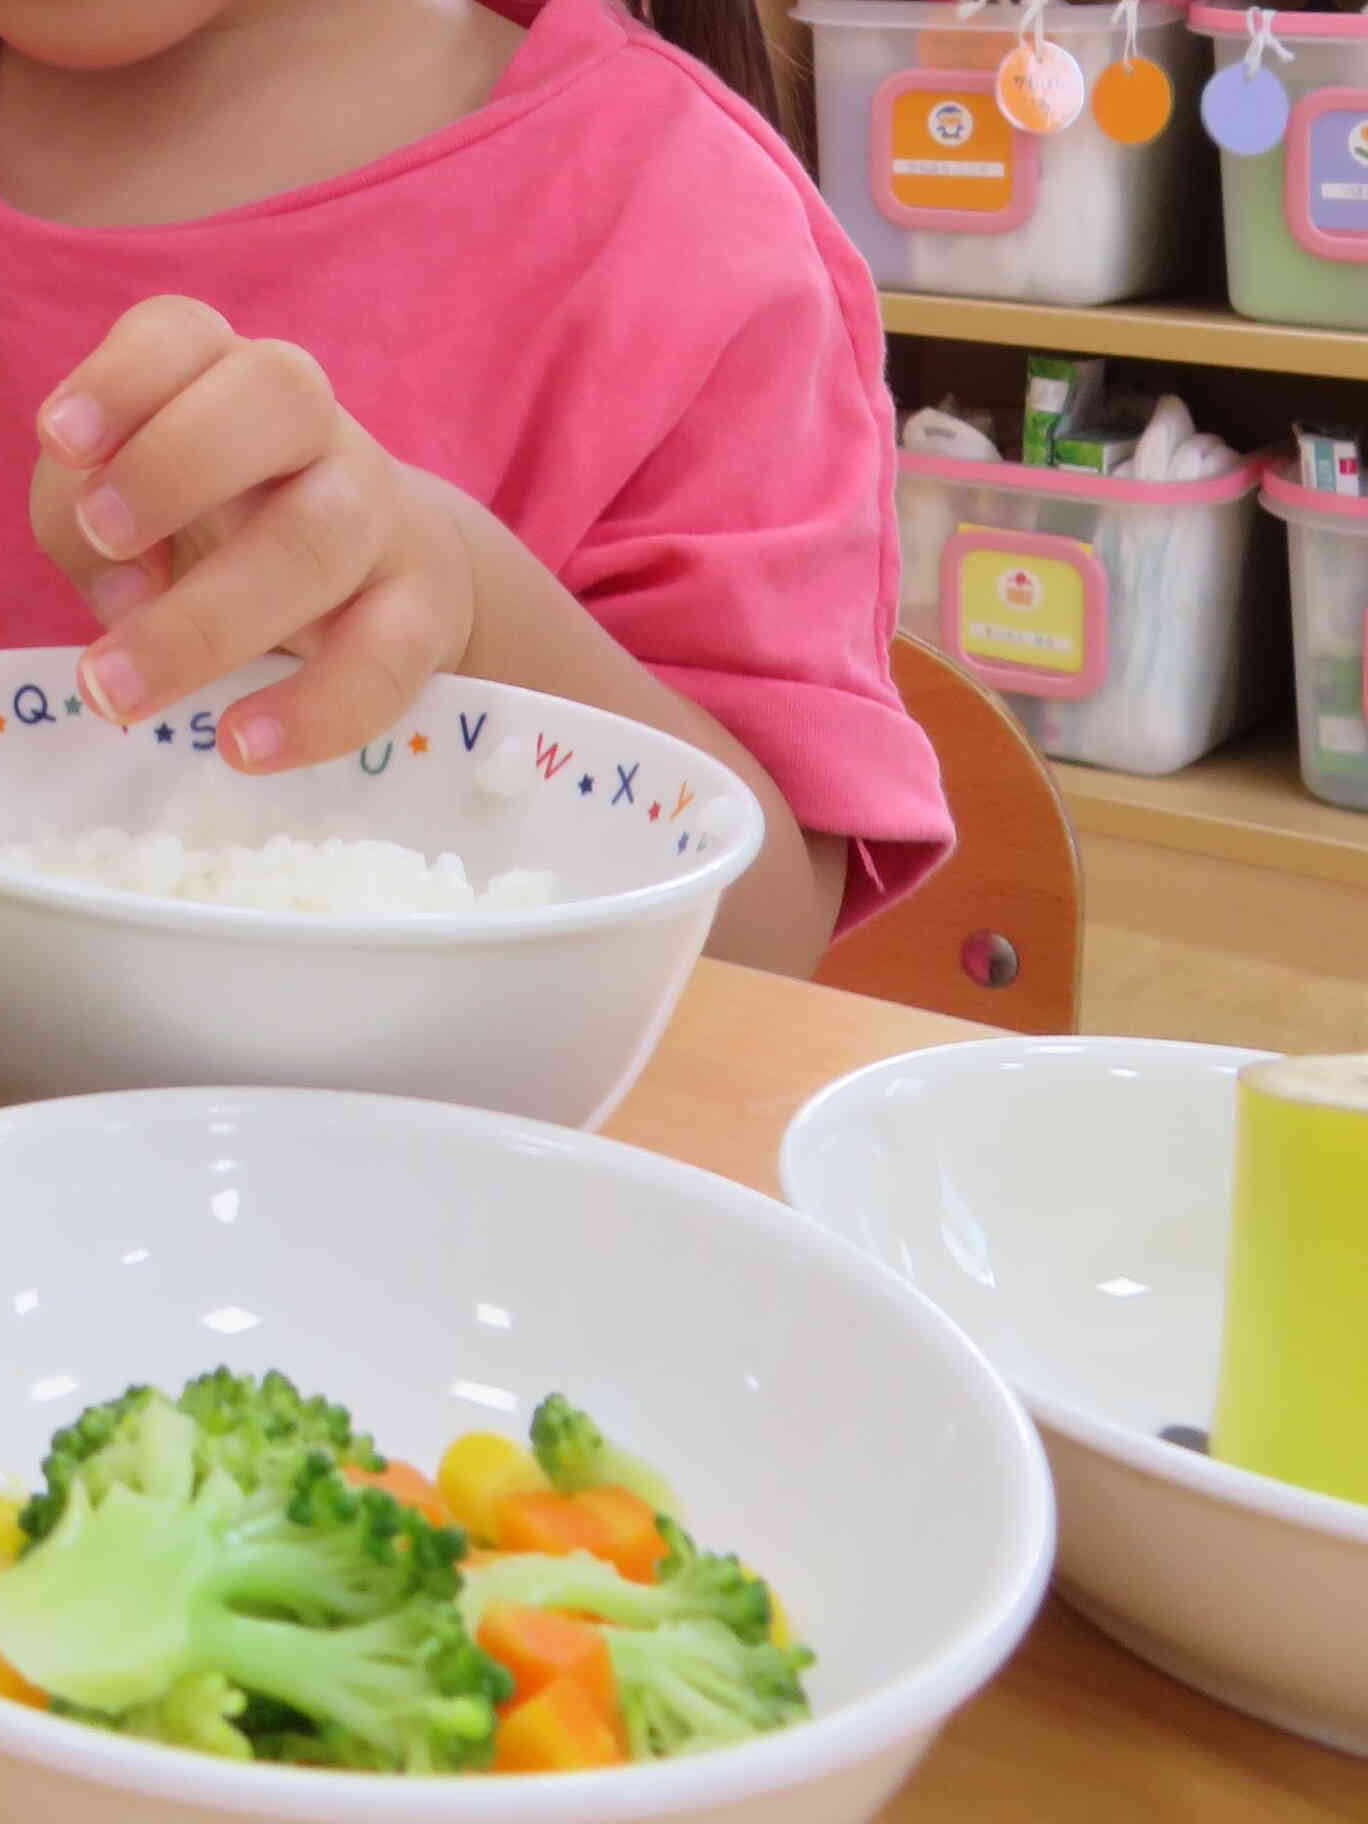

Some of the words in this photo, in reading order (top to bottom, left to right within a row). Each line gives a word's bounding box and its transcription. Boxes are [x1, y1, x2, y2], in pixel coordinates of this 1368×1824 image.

[10, 682, 58, 728] Q
[189, 711, 217, 752] S
[458, 711, 489, 753] V
[535, 731, 575, 782] W
[610, 761, 641, 807] X
